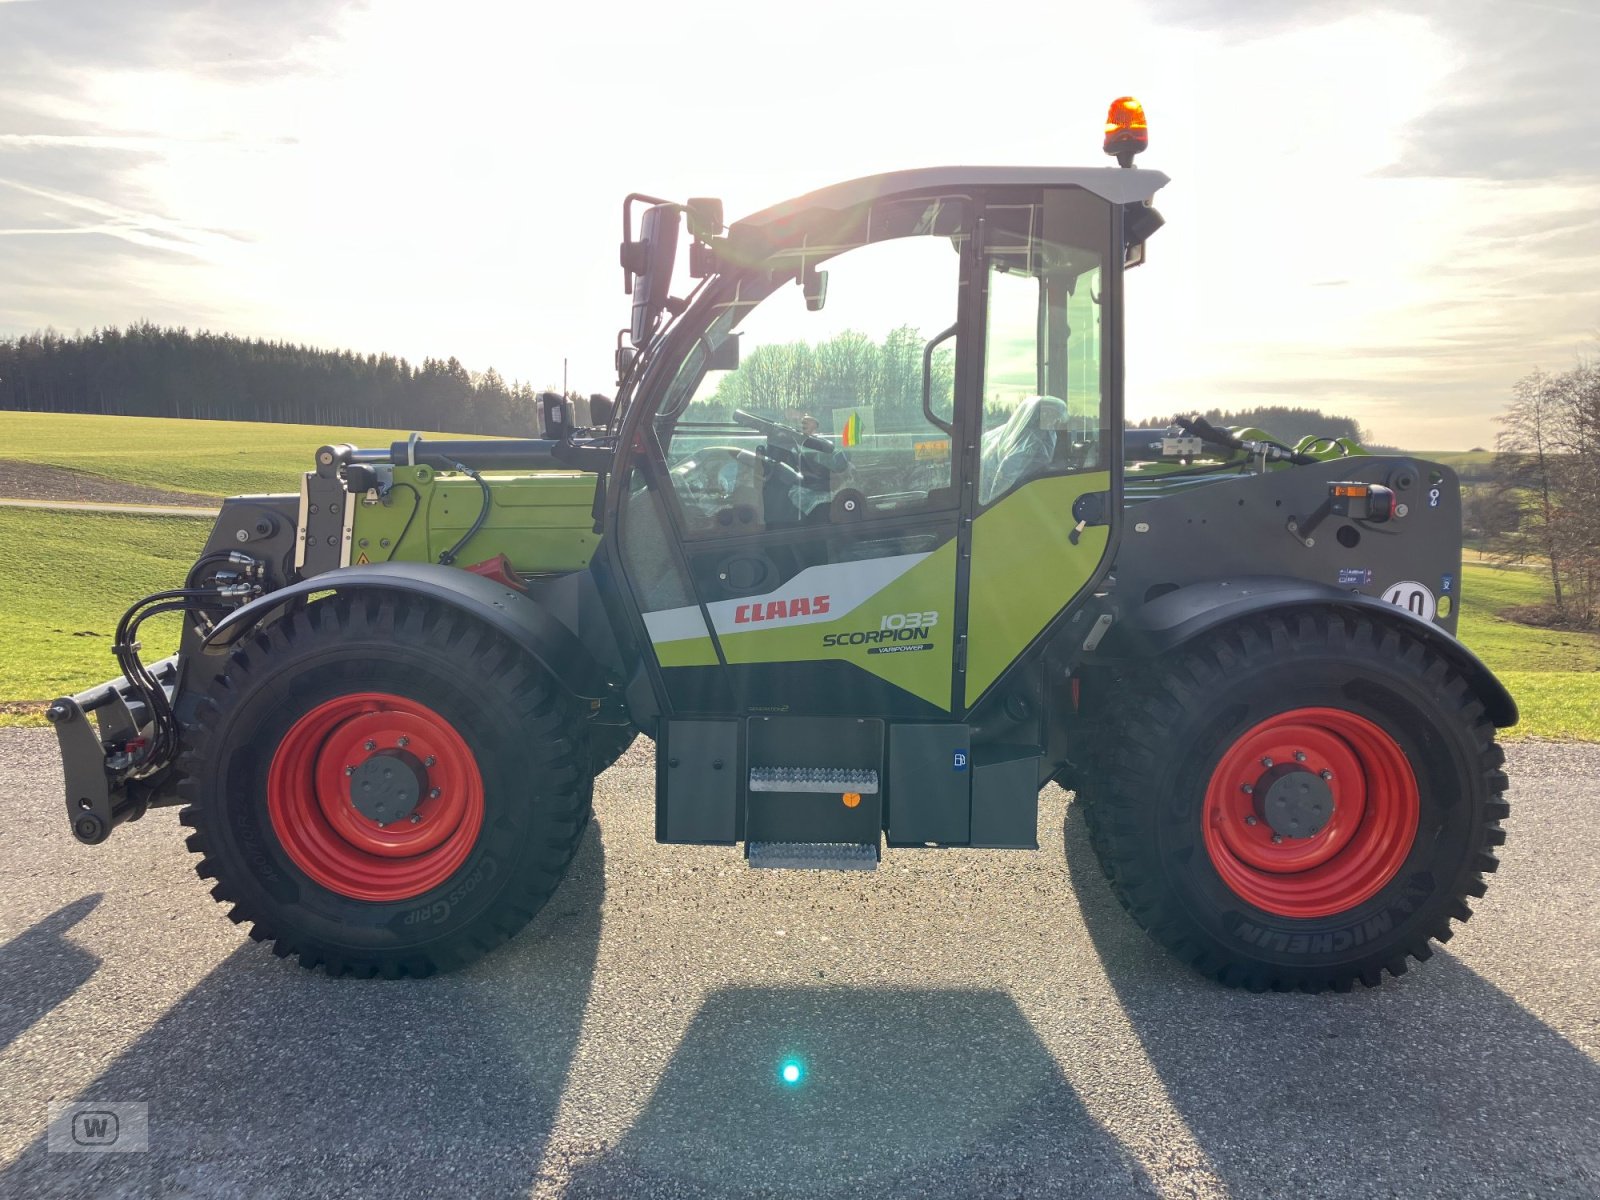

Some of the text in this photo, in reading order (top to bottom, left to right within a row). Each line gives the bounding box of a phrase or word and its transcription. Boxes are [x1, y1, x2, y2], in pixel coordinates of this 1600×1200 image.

[735, 595, 830, 623] CLAAS
[880, 610, 938, 630] 1033
[822, 627, 929, 647] SCORPION
[878, 644, 924, 653] VARIPOWER
[1235, 909, 1394, 953] MICHELIN
